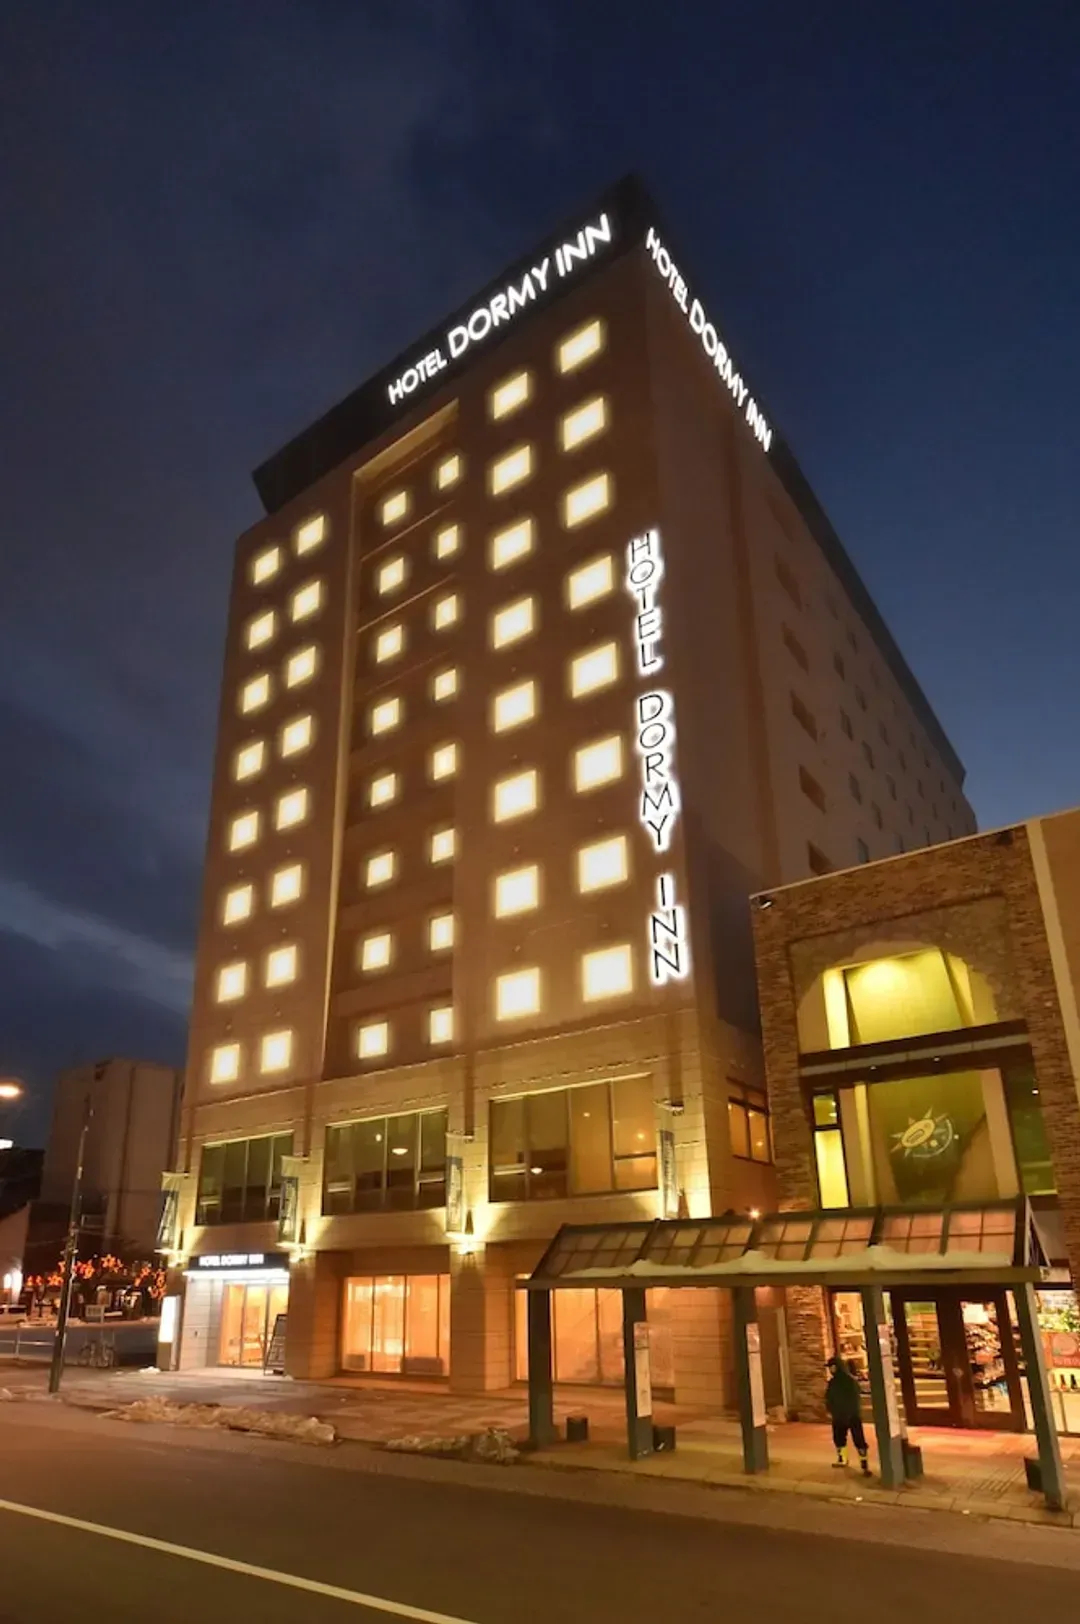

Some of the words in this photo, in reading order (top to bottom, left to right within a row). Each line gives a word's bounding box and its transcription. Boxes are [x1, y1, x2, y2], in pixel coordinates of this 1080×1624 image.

[387, 349, 448, 405] HOTEL
[448, 258, 550, 358] DORMY
[556, 213, 612, 277] INN
[646, 227, 688, 314] HOTEL
[689, 298, 748, 407] DORMY
[746, 397, 772, 452] INN
[627, 530, 659, 671] HOTEL
[638, 692, 676, 849] DORMY
[650, 875, 684, 981] INN
